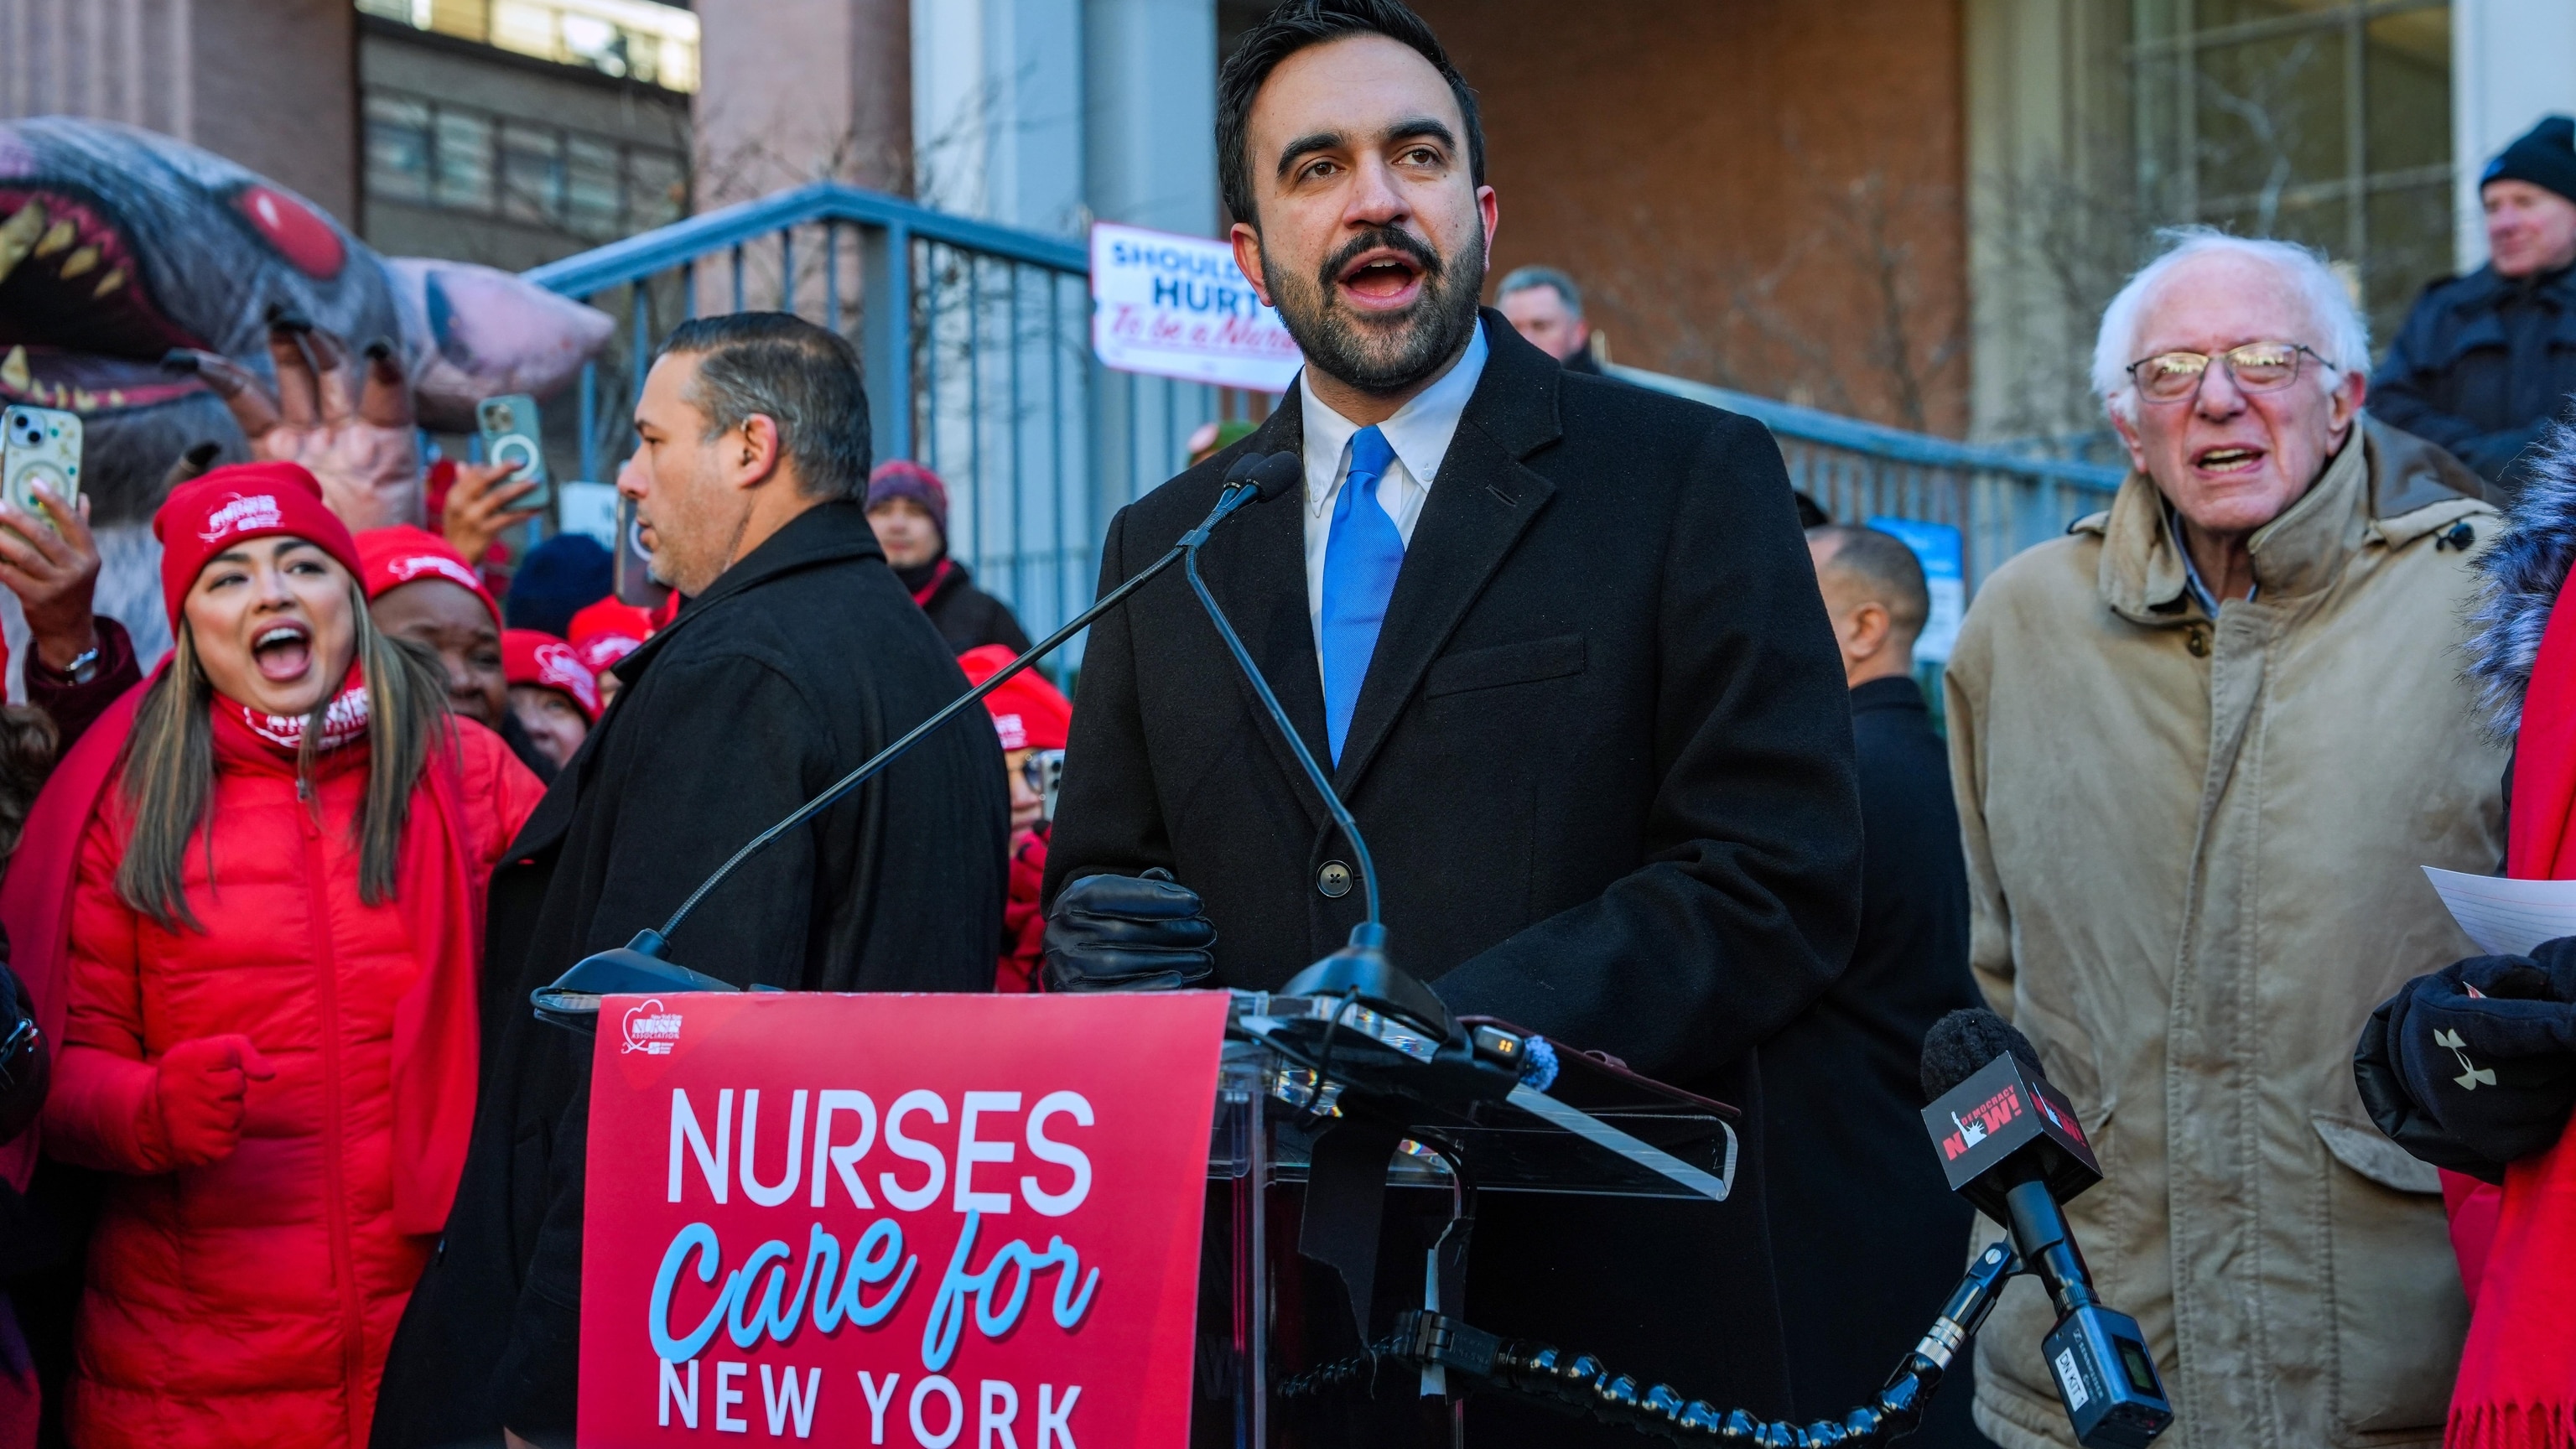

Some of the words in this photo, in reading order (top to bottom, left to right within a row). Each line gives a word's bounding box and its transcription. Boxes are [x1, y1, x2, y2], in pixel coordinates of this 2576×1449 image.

[1153, 276, 1262, 319] HURT
[1112, 303, 1143, 334] To
[1152, 309, 1179, 341] be
[1191, 325, 1208, 349] a
[632, 1018, 682, 1033] NURSES
[1961, 1084, 2015, 1125] DEMOCRACY
[667, 1088, 1095, 1216] NURSES
[648, 1217, 918, 1364] Care
[921, 1208, 1100, 1373] for
[2059, 1353, 2071, 1374] DN
[2067, 1374, 2081, 1396] KIT
[658, 1358, 822, 1438] NEW
[857, 1370, 1083, 1449] YORK
